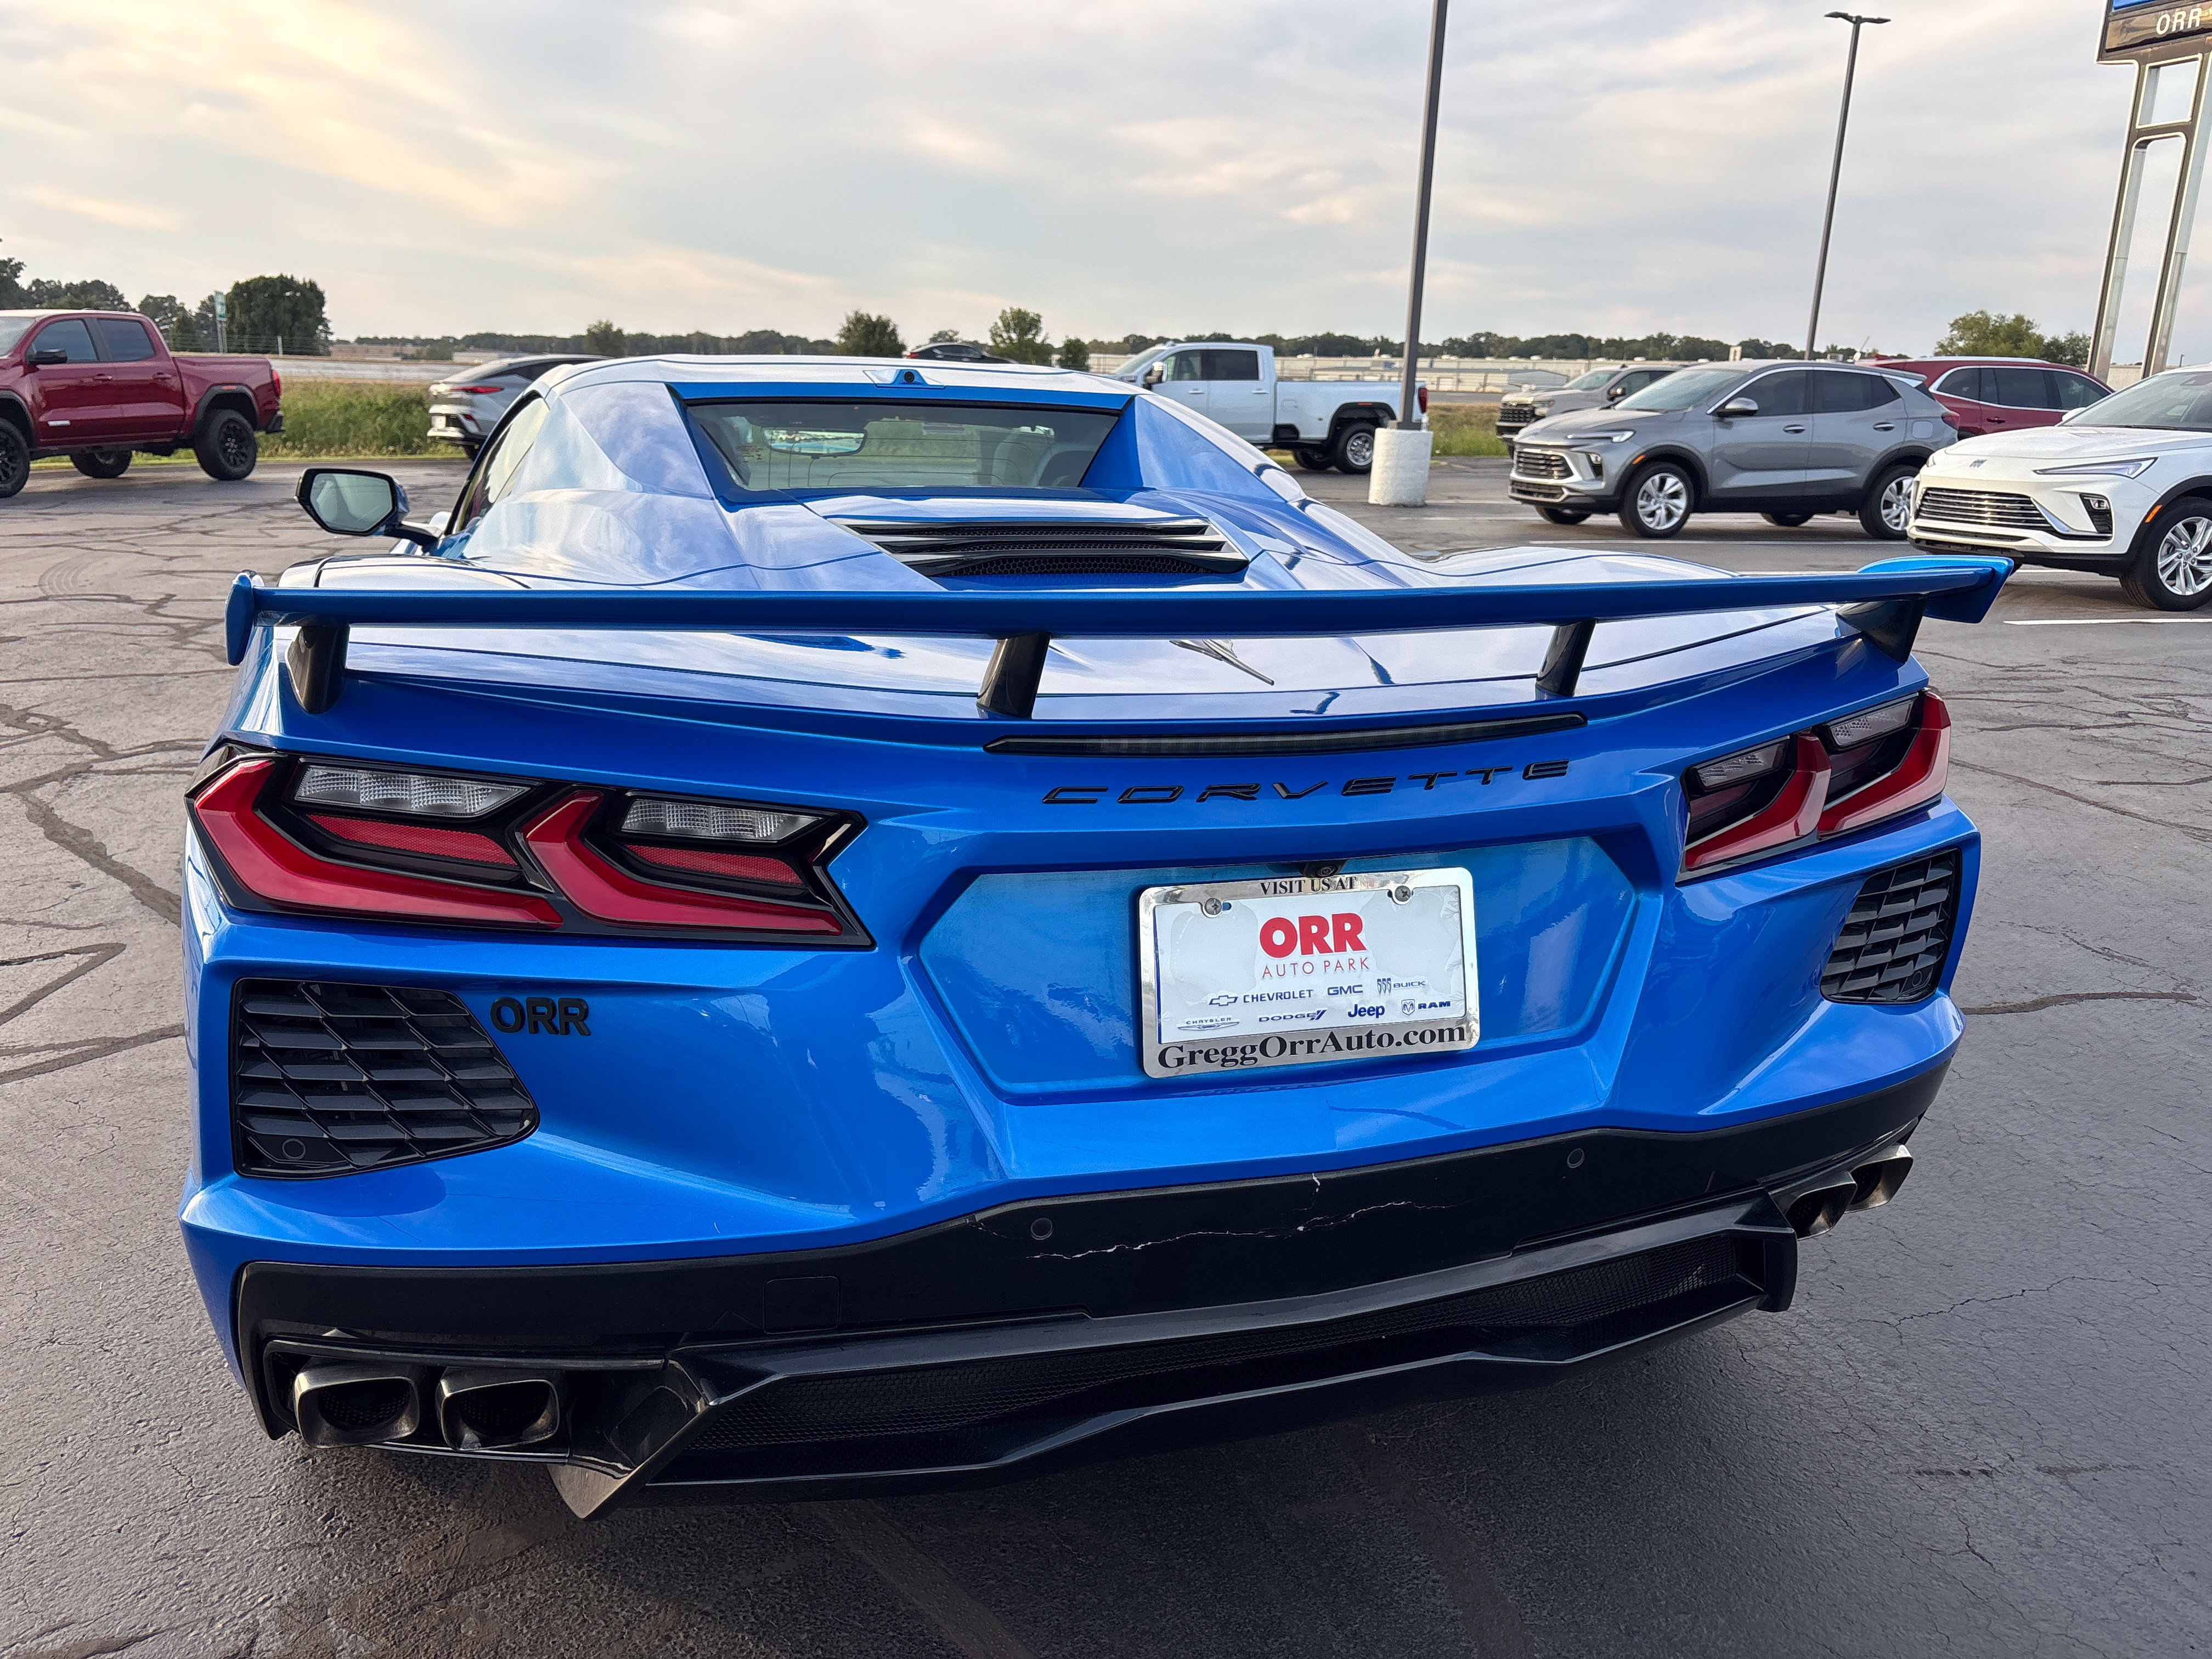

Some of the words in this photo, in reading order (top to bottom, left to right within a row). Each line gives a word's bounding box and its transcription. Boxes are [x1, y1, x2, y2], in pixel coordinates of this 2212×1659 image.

[2156, 7, 2202, 35] ORR
[1042, 759, 1569, 804] CORVETTE
[1260, 879, 1306, 895] VISIT
[1311, 878, 1331, 892] US
[1335, 876, 1356, 890] AT
[1260, 913, 1367, 958] ORR
[1262, 961, 1314, 979] AUTO
[1323, 957, 1369, 973] PARK
[1243, 989, 1313, 1003] CHEVROLET
[1327, 984, 1363, 996] GMC
[1347, 1004, 1385, 1018] Jeep
[1418, 1001, 1451, 1009] RAM
[490, 996, 591, 1036] ORR
[1186, 1017, 1232, 1025] CHRYSLER
[1259, 1012, 1317, 1022] DODGE
[1158, 1026, 1466, 1068] GreggOrrAuto.com
